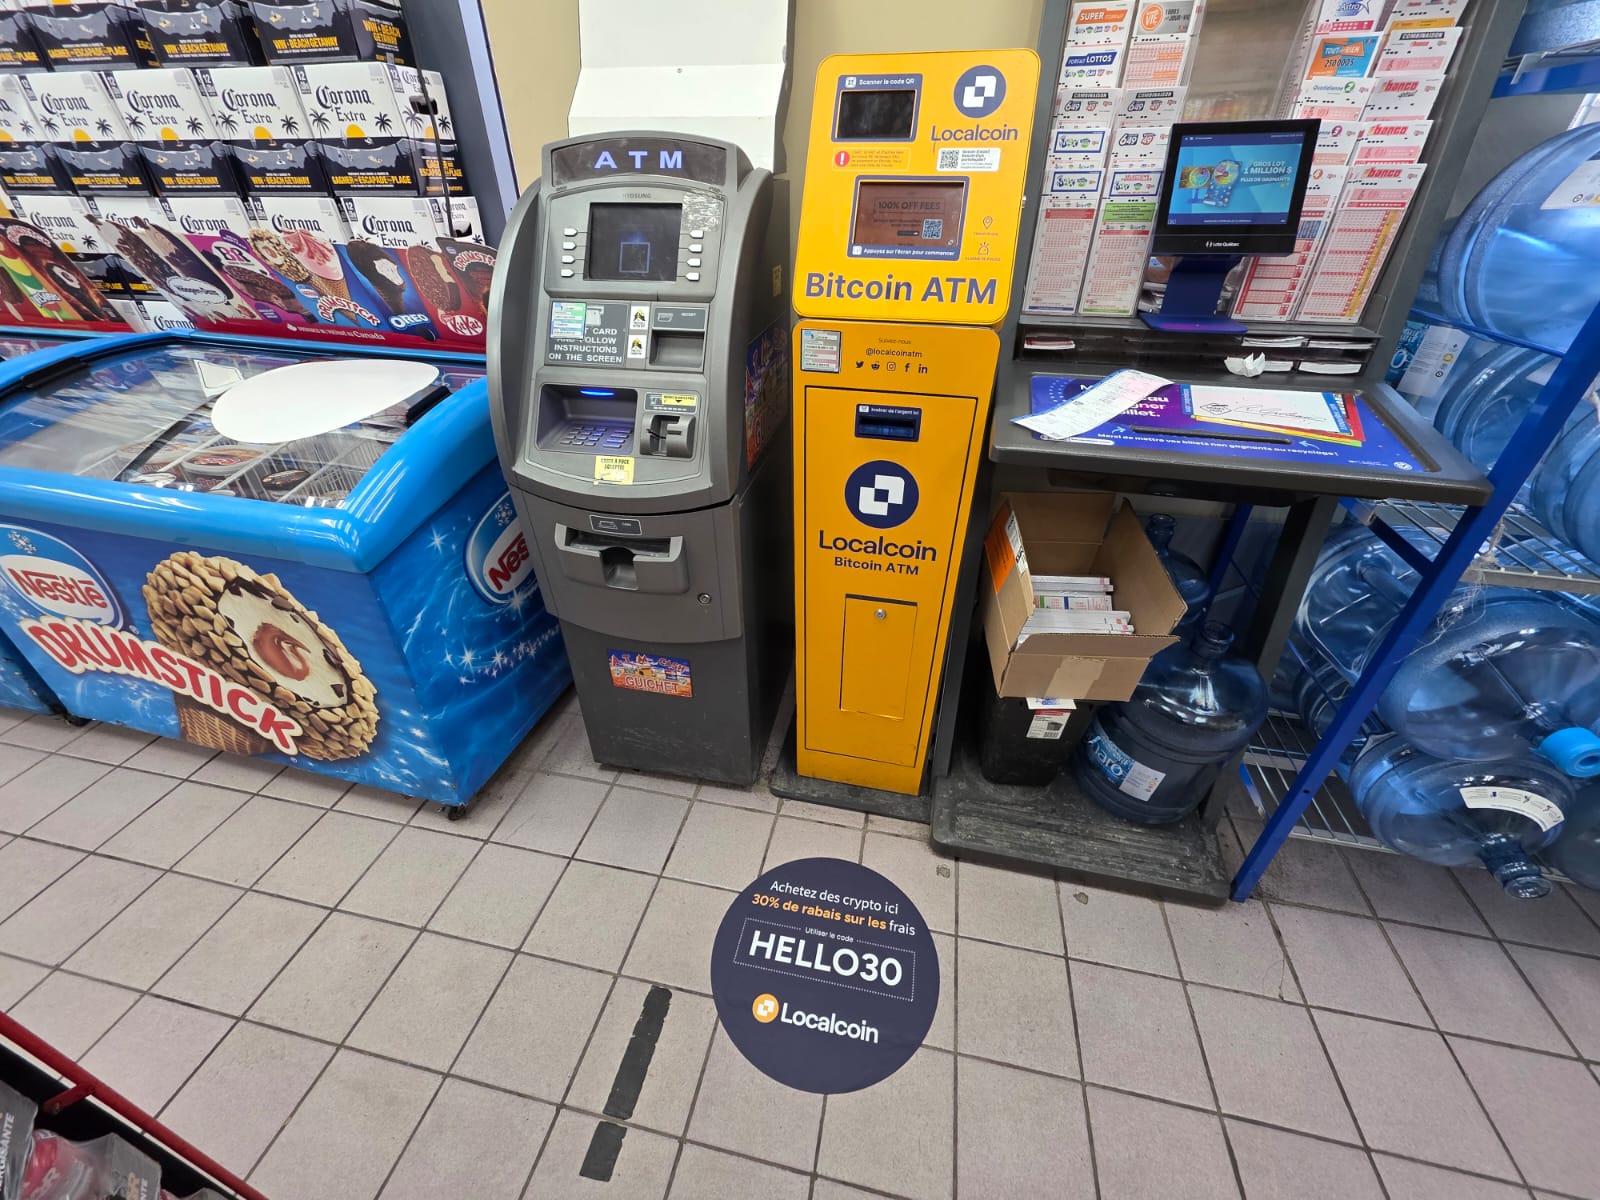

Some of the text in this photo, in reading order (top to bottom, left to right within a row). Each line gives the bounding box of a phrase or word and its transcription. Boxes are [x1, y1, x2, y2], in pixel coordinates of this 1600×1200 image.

[1080, 12, 1104, 20] SUPER
[1086, 54, 1112, 64] LOTTOS
[202, 74, 212, 84] 12
[297, 70, 306, 81] 12
[858, 78, 881, 86] Scanner
[1383, 80, 1419, 92] banco
[40, 92, 90, 115] Corona
[126, 90, 181, 114] Corona
[222, 88, 276, 112] Corona
[316, 85, 371, 109] Corona
[62, 113, 88, 127] Extra
[149, 110, 178, 125] Extra
[242, 109, 273, 124] Extra
[336, 106, 367, 122] Extra
[931, 124, 1018, 142] Localcoin
[1372, 124, 1408, 135] banco
[1366, 168, 1402, 178] banco
[162, 202, 170, 211] 12
[254, 202, 262, 211] 12
[345, 202, 353, 212] 12
[901, 202, 918, 210] OFF
[919, 202, 941, 210] FEES
[30, 212, 76, 230] Corona
[180, 215, 228, 234] Corona
[272, 214, 322, 233] Corona
[362, 214, 414, 235] Corona
[51, 229, 76, 241] Extra
[381, 234, 408, 247] Extra
[806, 272, 998, 304] Bitcoin ATM
[317, 296, 380, 326] DRUMSTICK
[390, 314, 428, 328] OREO
[448, 315, 483, 336] KitKat
[592, 328, 618, 336] CARD
[554, 344, 618, 354] INSTRUCTIONS
[866, 348, 923, 358] @localcoinatm
[566, 354, 582, 362] THE
[586, 354, 622, 363] SCREEN
[819, 530, 937, 562] Localcoin
[834, 556, 919, 576] Bitcoin ATM
[28, 622, 296, 750] DRUMSTICK
[626, 676, 679, 693] GUICHET
[770, 880, 898, 914] Achetez des crypto ici
[752, 894, 916, 936] 30% de rabais sur les frais
[805, 926, 854, 943] Utiliser le code
[749, 930, 903, 986] HELLO30
[780, 1002, 880, 1044] Localcoin
